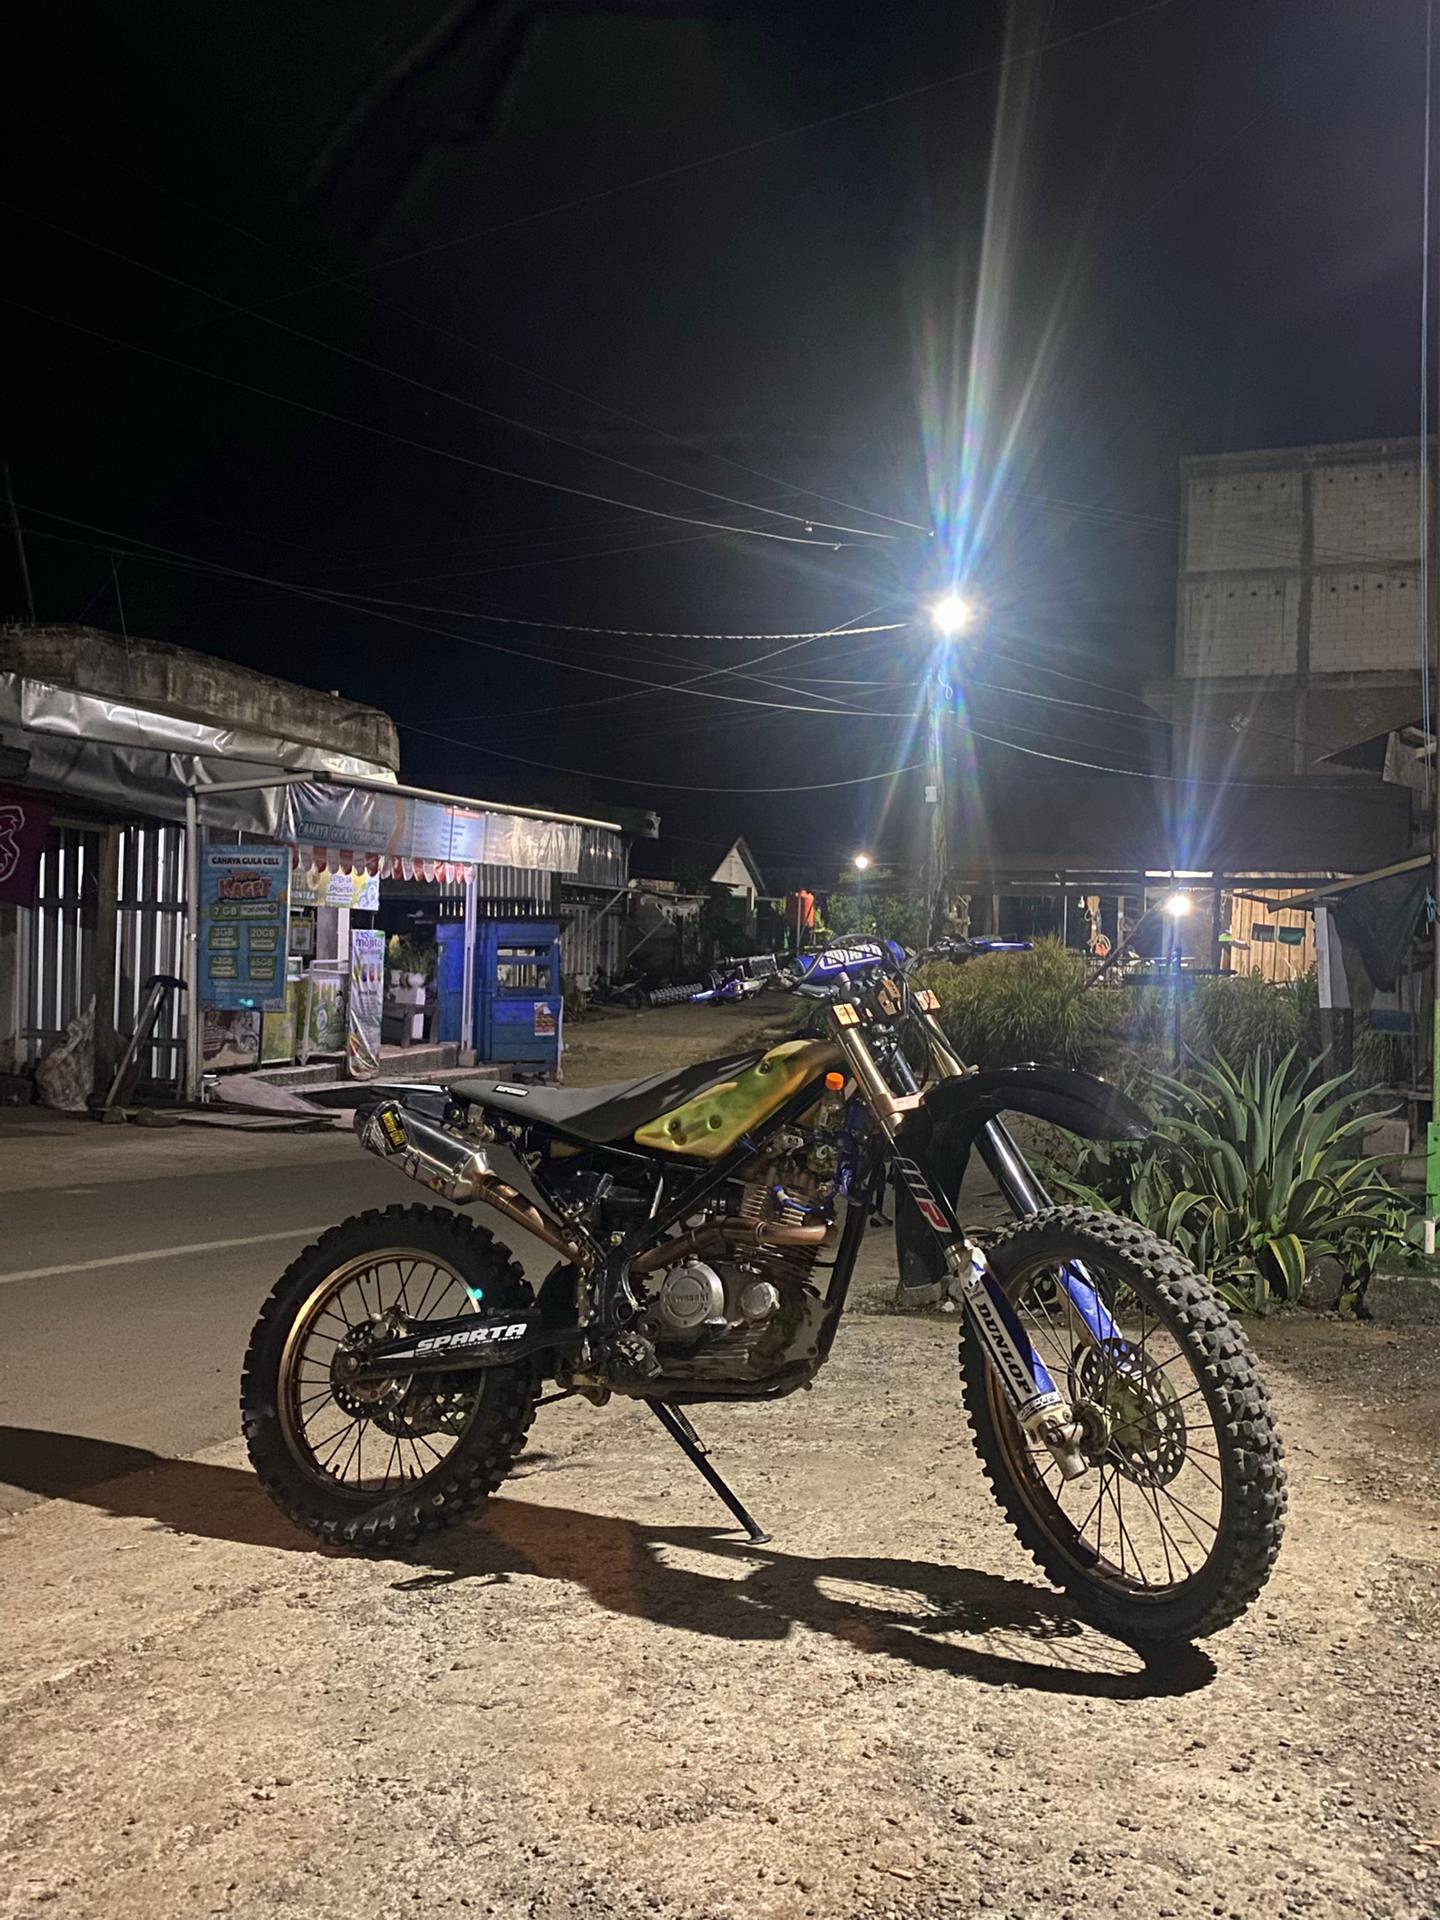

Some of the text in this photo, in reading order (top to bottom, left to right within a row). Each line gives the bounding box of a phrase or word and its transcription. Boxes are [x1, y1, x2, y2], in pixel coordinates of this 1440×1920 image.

[211, 857, 279, 865] CAHAYA GULA CELL
[223, 906, 238, 915] GB
[250, 928, 275, 937] 20GB
[415, 1323, 528, 1353] SPARTA
[976, 1302, 1032, 1394] DUNLOP
